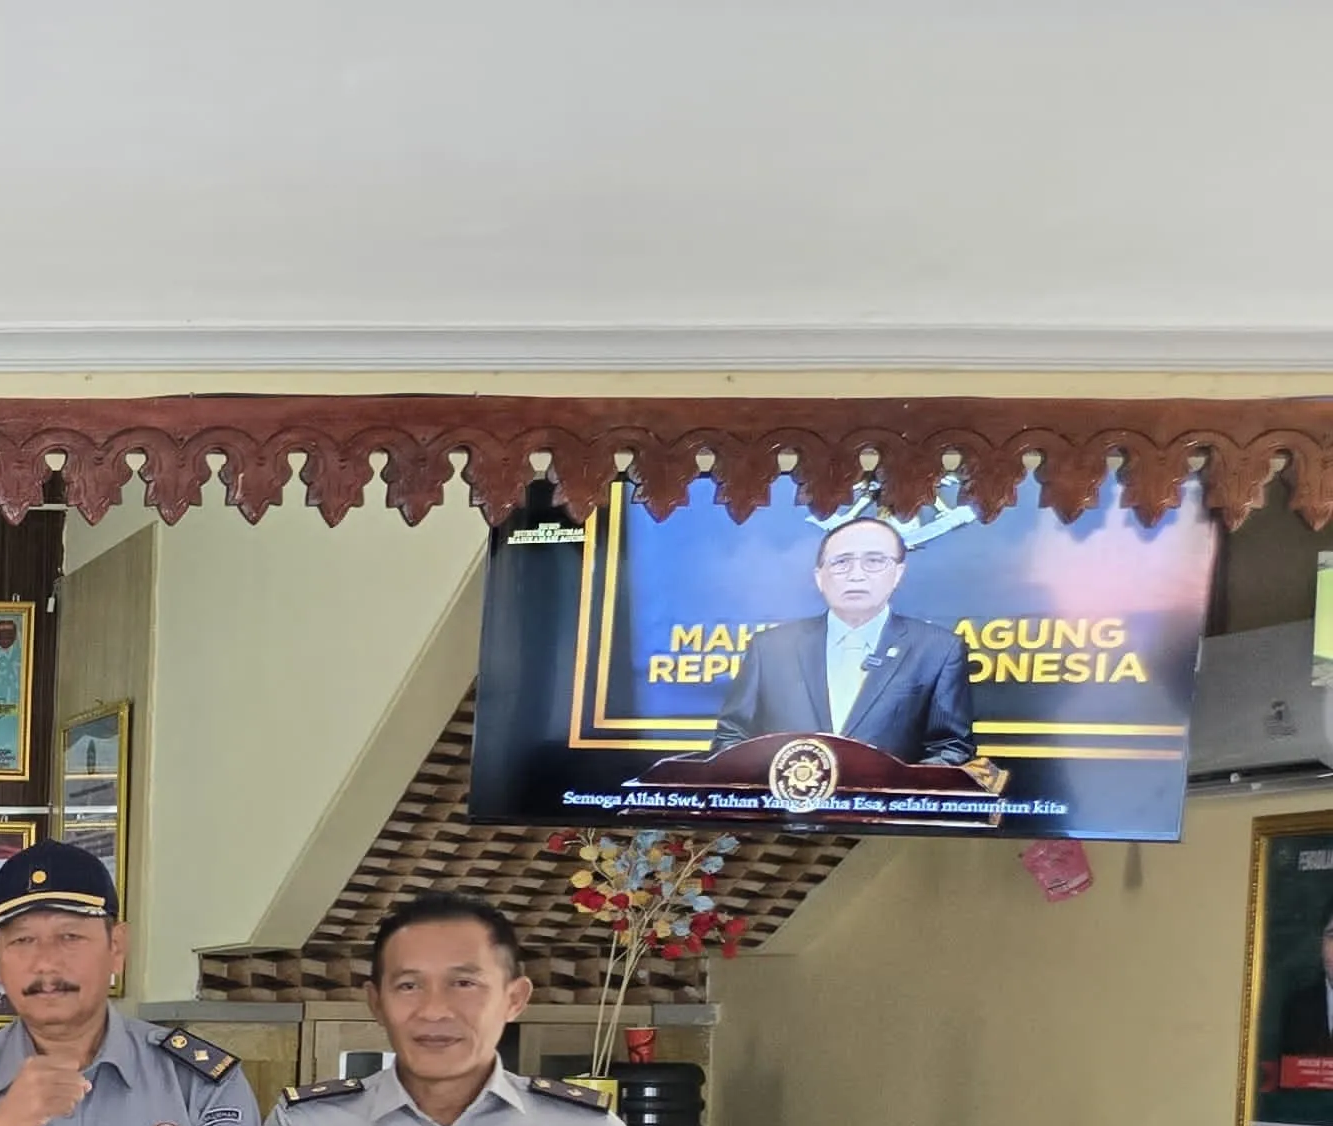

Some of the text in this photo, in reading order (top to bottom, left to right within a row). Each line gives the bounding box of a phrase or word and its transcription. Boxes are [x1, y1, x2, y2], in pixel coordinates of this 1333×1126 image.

[954, 617, 1127, 650] AGUNG
[966, 651, 1150, 684] ONESIA
[563, 791, 621, 808] Semoga
[624, 791, 665, 807] Allah
[709, 794, 758, 808] Tuhan
[761, 795, 800, 811] Yang
[804, 796, 850, 809] Maha
[853, 796, 886, 812] Esa,
[889, 797, 937, 812] selalu
[941, 800, 1030, 814] menuntun
[1033, 800, 1068, 815] kita
